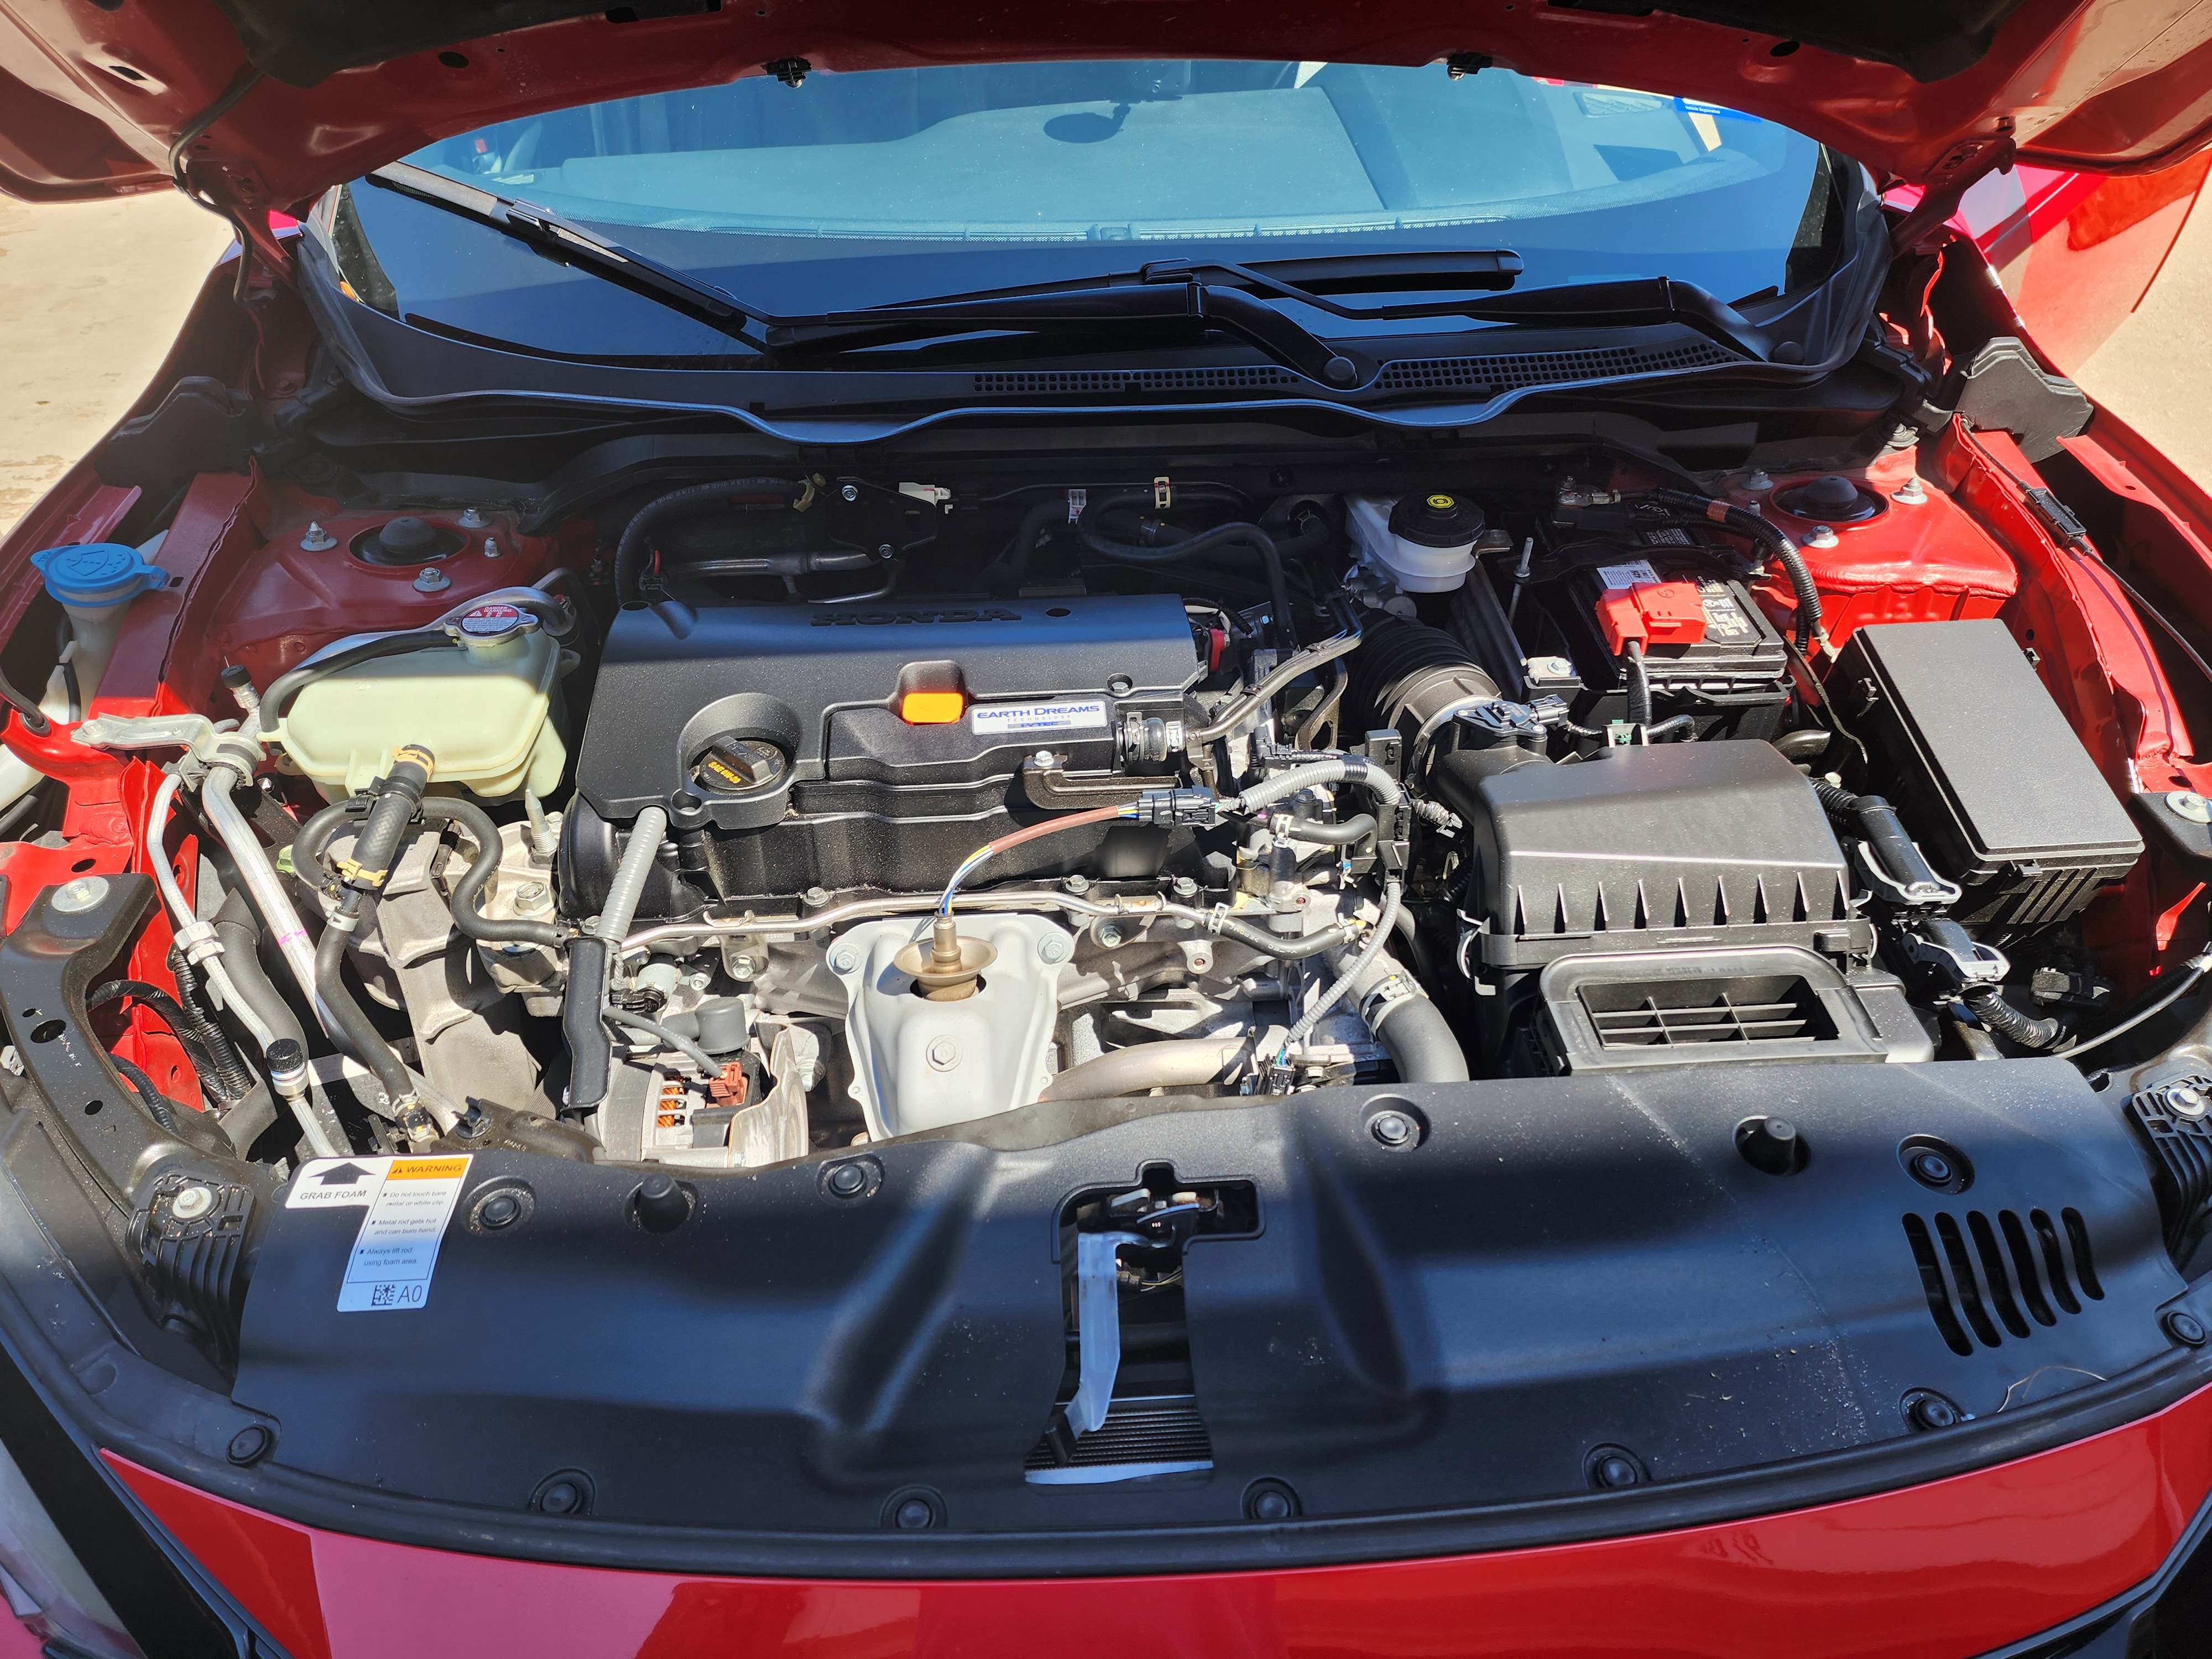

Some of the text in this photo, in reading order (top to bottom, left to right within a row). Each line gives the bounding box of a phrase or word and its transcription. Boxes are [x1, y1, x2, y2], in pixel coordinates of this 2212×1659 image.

[811, 608, 1022, 626] HONDA
[977, 706, 1099, 718] EARTH DREAMS
[708, 761, 725, 773] SAE
[720, 769, 741, 784] 0W-20
[407, 1164, 462, 1173] WARNING
[300, 1190, 367, 1200] GRAB FOAM
[397, 1285, 422, 1304] A0
